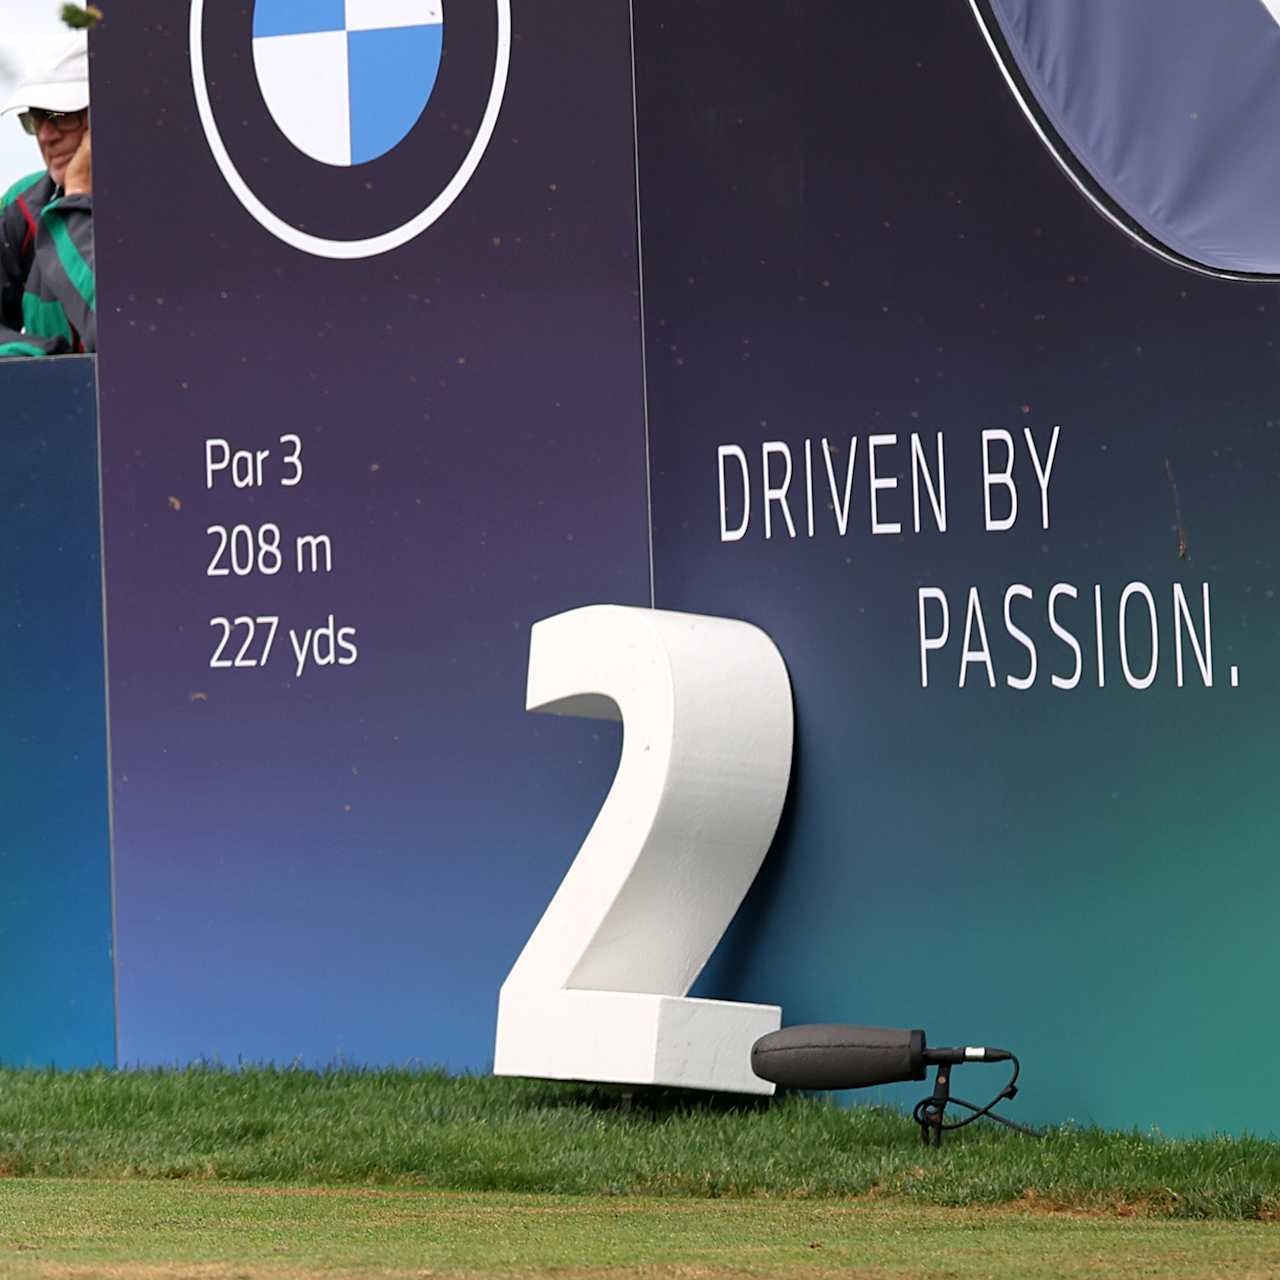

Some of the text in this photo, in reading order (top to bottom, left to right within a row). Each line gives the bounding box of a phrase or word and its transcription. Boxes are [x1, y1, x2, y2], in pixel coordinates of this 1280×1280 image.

[205, 433, 303, 489] Par 3
[717, 425, 1061, 542] DRIVEN BY
[206, 522, 332, 576] 208 m
[209, 613, 358, 678] 227 yds
[918, 581, 1239, 690] PASSION.
[493, 603, 795, 1096] 2
